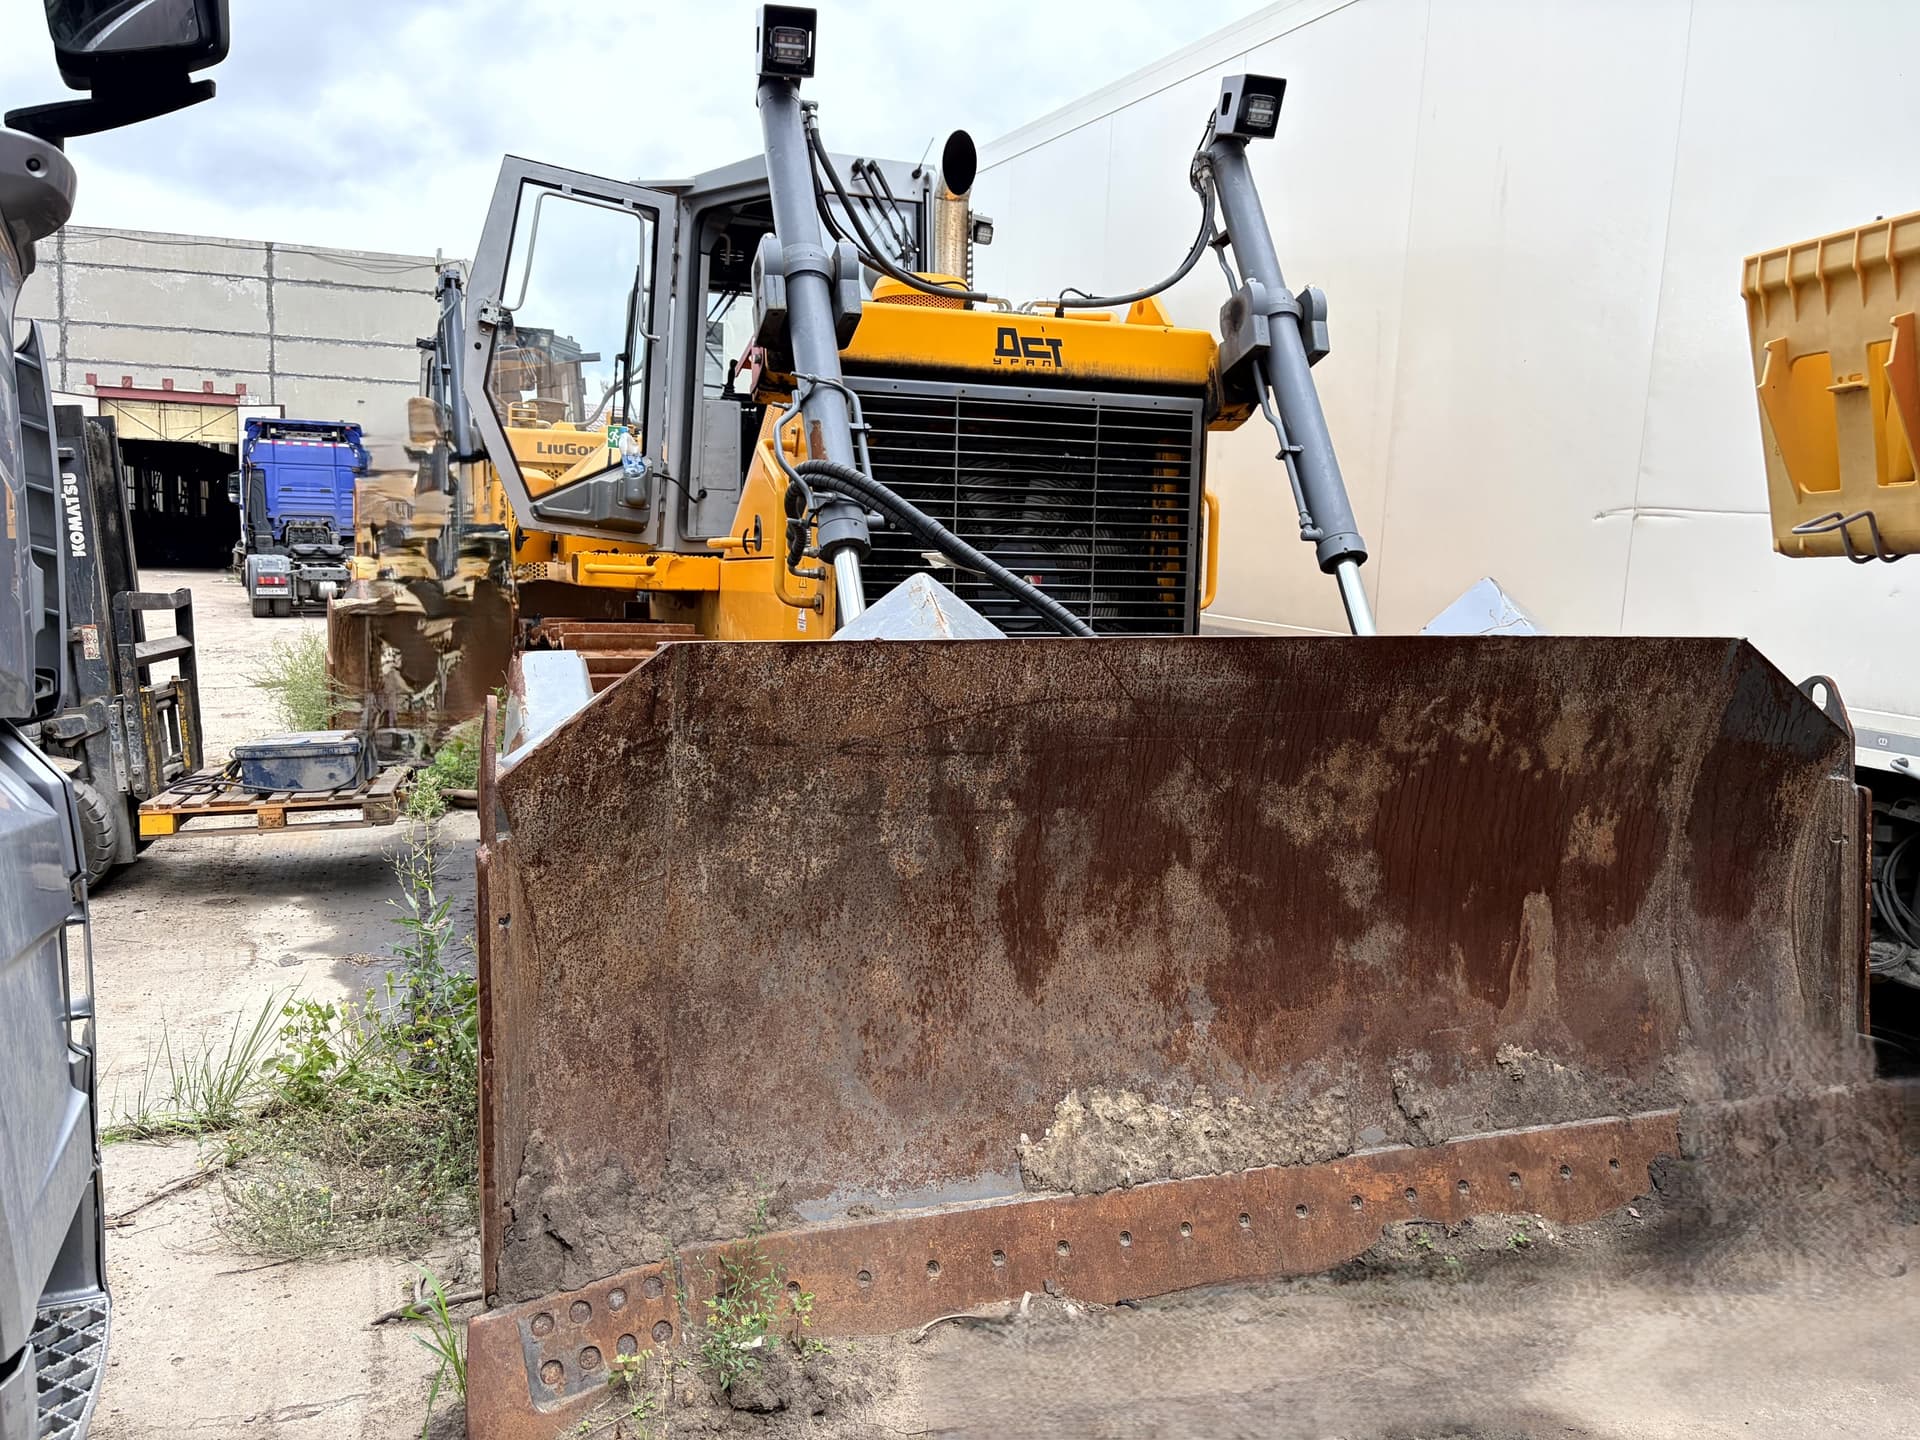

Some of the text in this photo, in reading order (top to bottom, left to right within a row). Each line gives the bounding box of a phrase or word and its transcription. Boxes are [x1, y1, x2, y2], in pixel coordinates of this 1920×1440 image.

[993, 357, 1051, 367] УРАЛ
[995, 327, 1063, 367] ДСТ
[61, 472, 87, 557] KOMATSU
